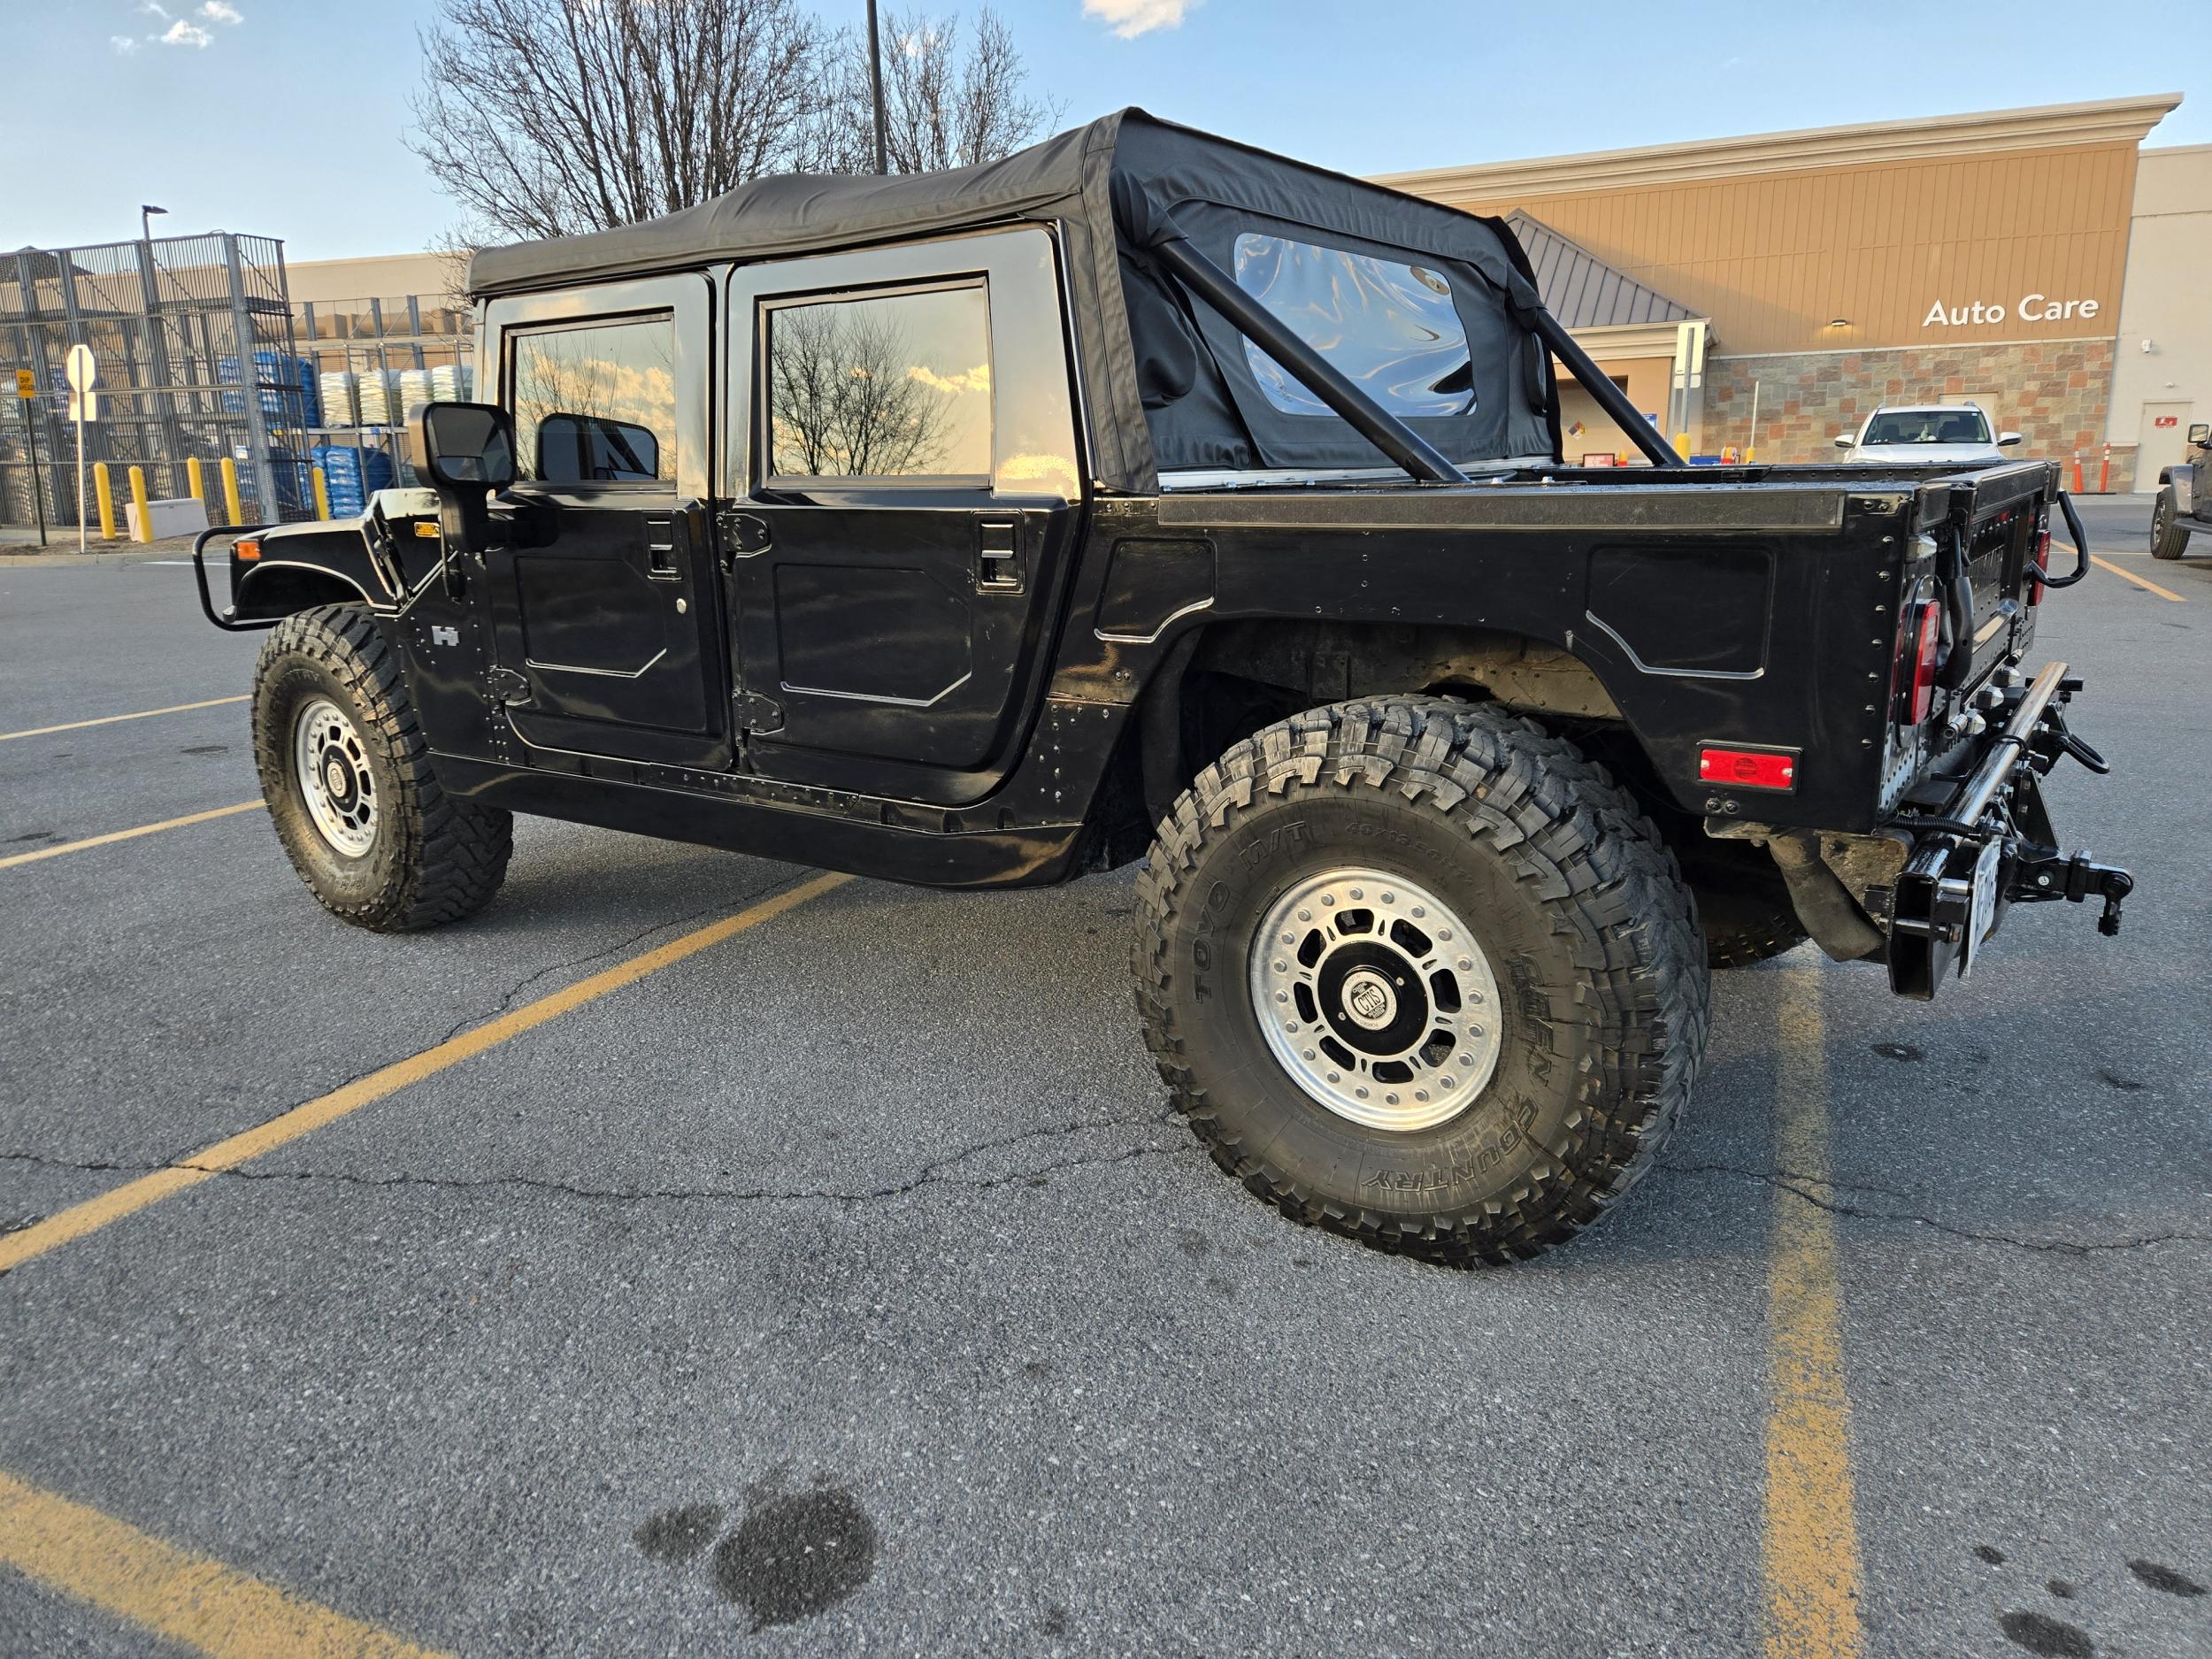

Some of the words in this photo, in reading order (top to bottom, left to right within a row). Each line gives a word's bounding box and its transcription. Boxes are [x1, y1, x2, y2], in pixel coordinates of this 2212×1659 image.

[1922, 299, 2007, 327] Auto
[2018, 294, 2100, 321] Care
[1191, 879, 1231, 1004] TOYO
[1238, 820, 1307, 871] M/T
[1357, 988, 1381, 1011] CTIS
[1511, 953, 1554, 1087] OPEN
[1361, 1096, 1540, 1192] COUNTRY
